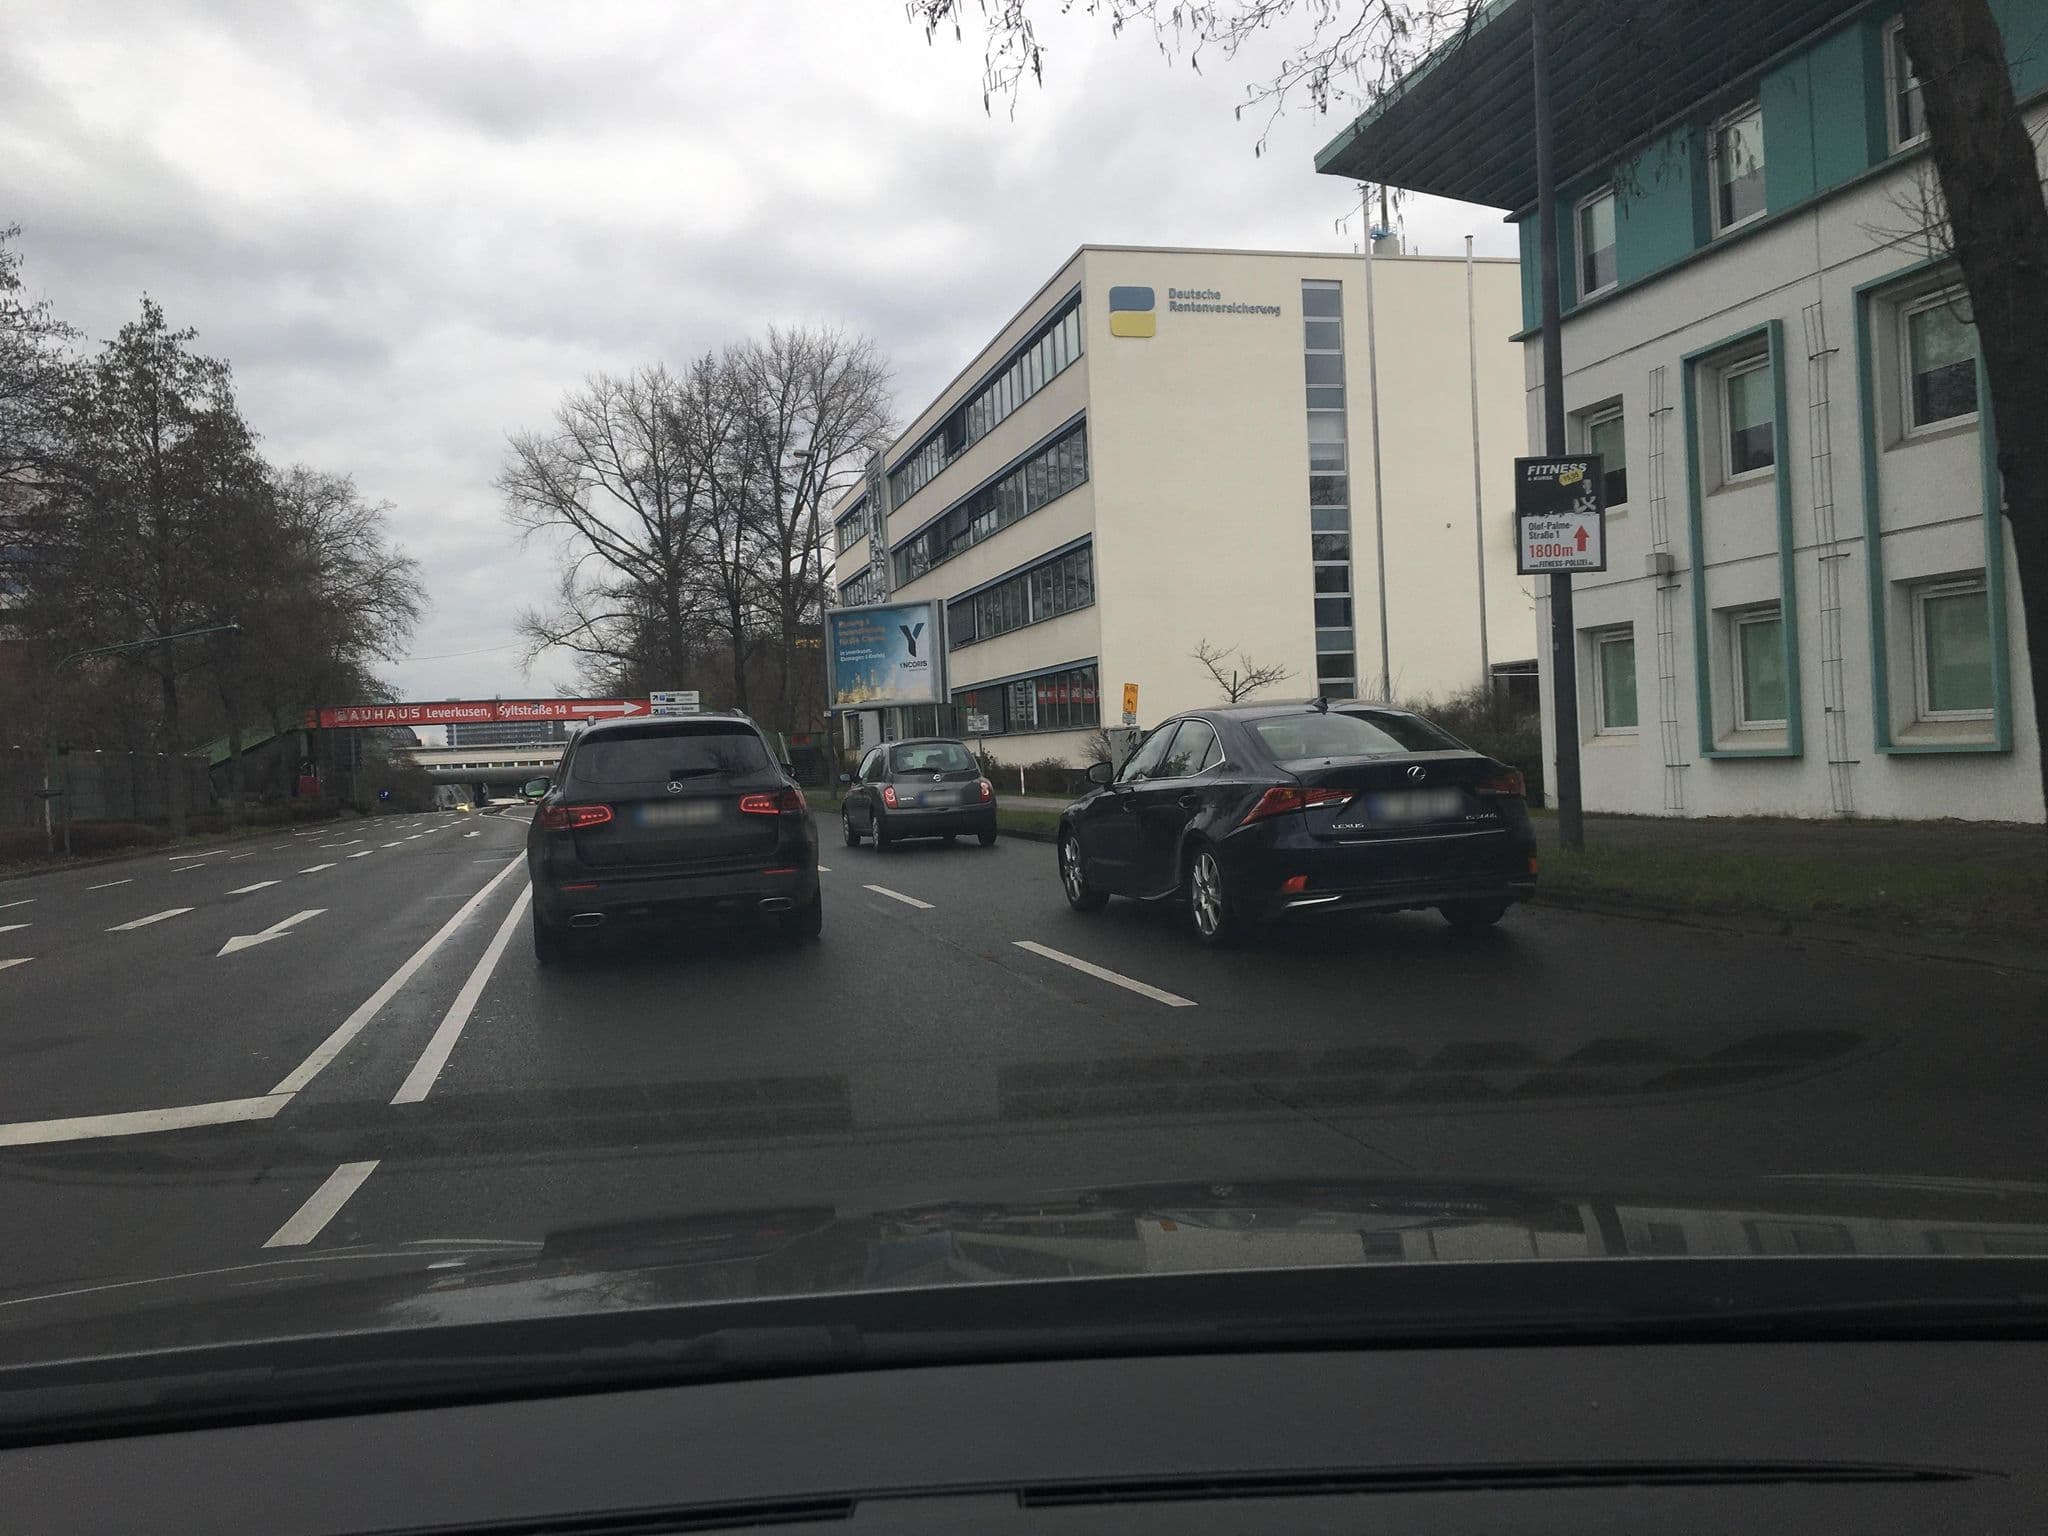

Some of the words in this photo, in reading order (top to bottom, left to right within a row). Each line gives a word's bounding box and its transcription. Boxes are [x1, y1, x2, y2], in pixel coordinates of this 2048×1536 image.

[1169, 288, 1221, 300] Deutsche
[1169, 301, 1281, 317] Rentenversicherung
[1528, 463, 1587, 475] FITNESS
[1528, 531, 1554, 540] Straße
[1556, 530, 1560, 539] 1
[1529, 544, 1573, 558] 1800m
[336, 708, 420, 721] BAUHAUS
[426, 706, 491, 718] Leverkusen,
[499, 704, 552, 718] Syltstraße
[555, 705, 566, 715] 14
